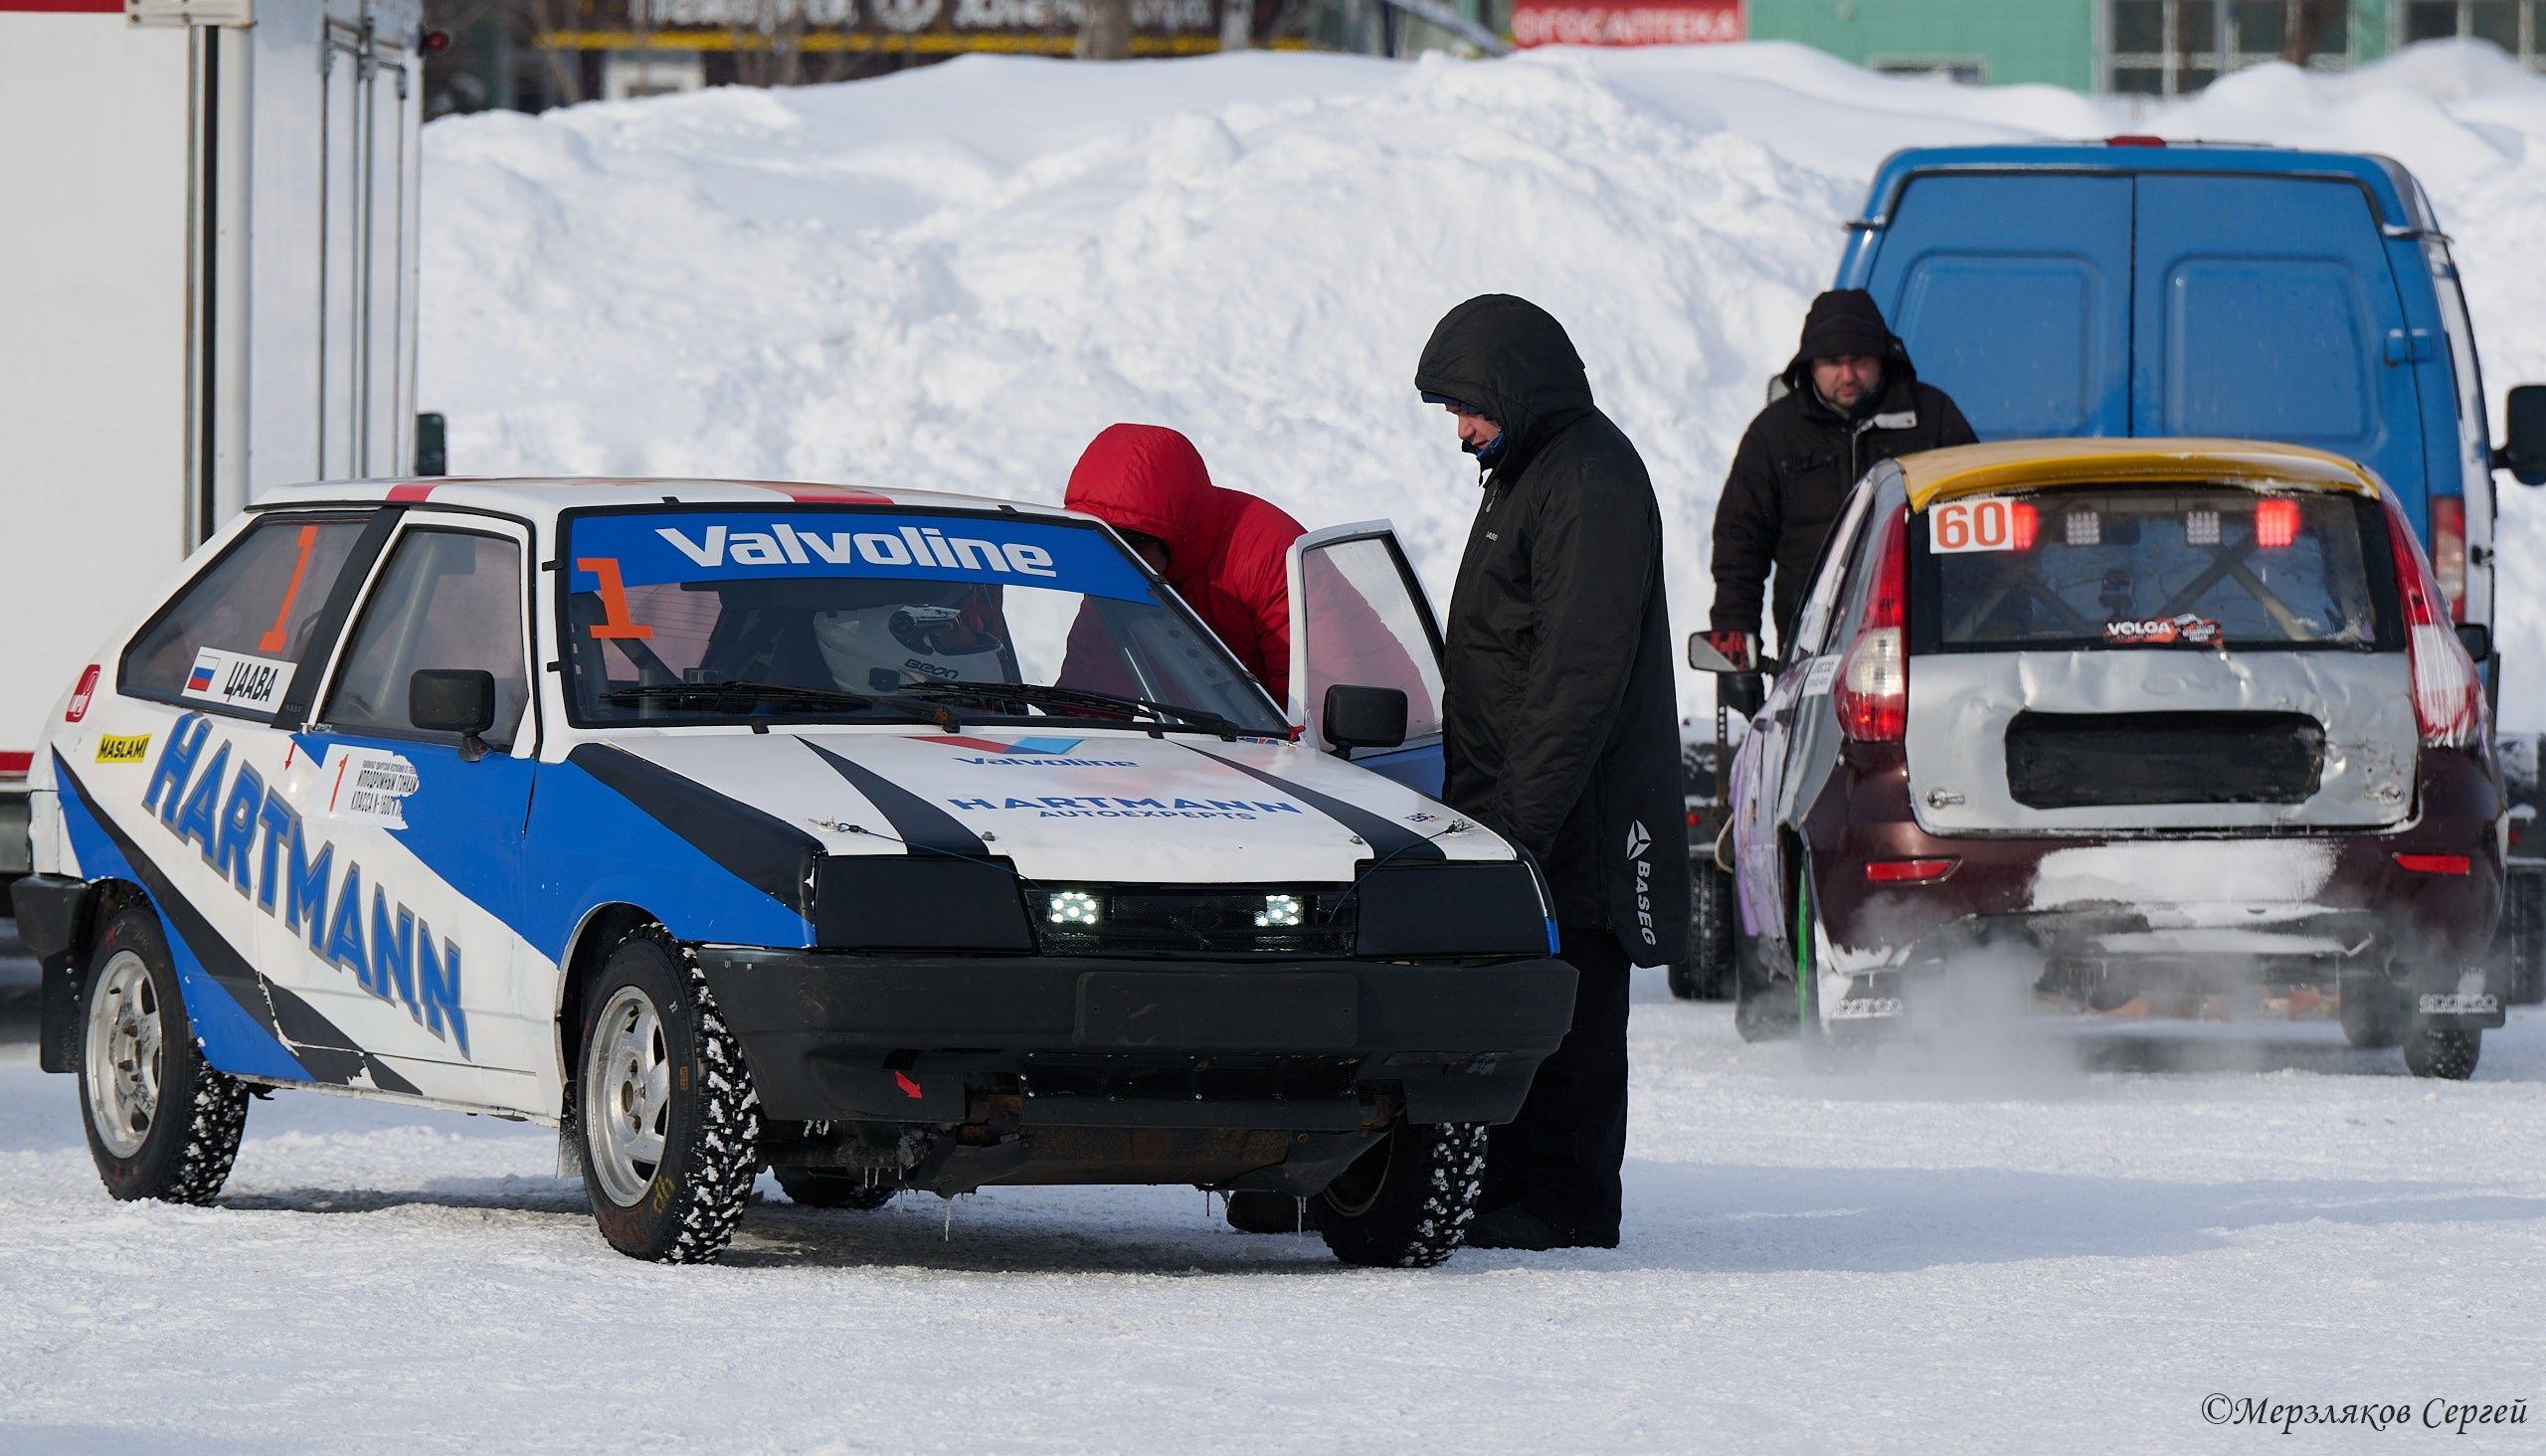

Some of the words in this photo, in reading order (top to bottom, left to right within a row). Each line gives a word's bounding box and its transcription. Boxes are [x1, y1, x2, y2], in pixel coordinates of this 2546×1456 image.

[654, 523, 1057, 578] Valvoline
[1936, 501, 2007, 550] 60
[259, 525, 318, 652] 1
[577, 557, 653, 638] 1
[2106, 621, 2172, 636] VOLGA
[223, 660, 279, 702] ЦААВА
[97, 737, 150, 758] MASLAMI
[952, 757, 1141, 768] Valvoline
[329, 753, 349, 812] 1
[947, 796, 1304, 815] HARTMANN
[141, 710, 471, 1063] HARTMANN
[1635, 860, 1657, 946] BASEG
